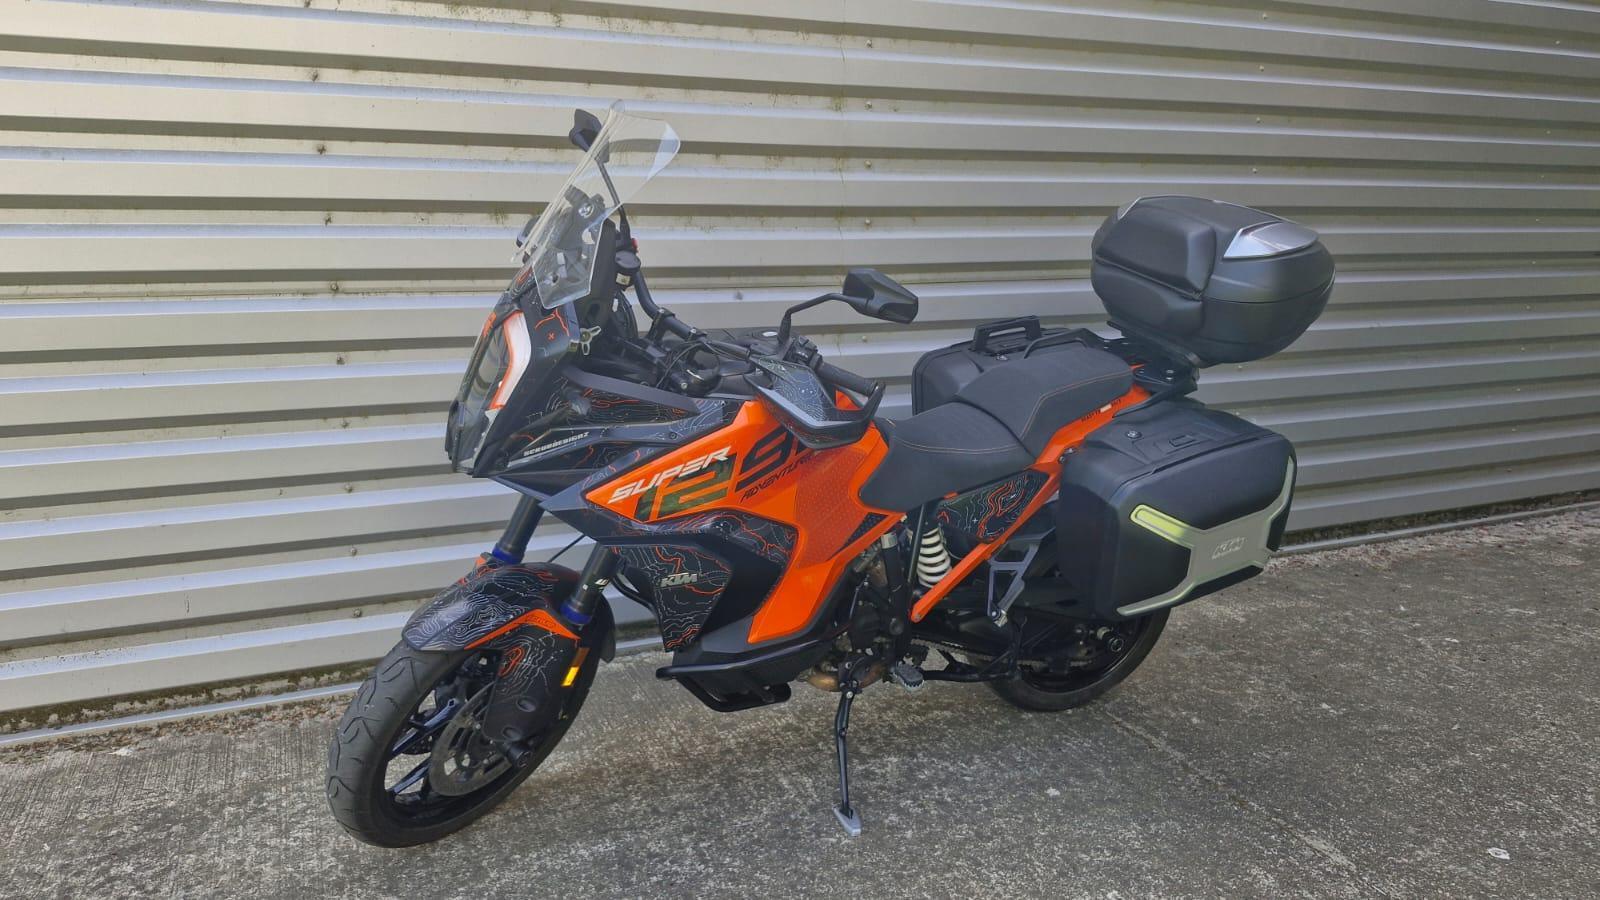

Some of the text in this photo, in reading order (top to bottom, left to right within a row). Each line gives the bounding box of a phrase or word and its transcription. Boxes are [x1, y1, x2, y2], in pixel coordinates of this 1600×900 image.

[607, 446, 731, 504] SUPER
[633, 423, 808, 522] 129
[660, 572, 698, 588] KTM
